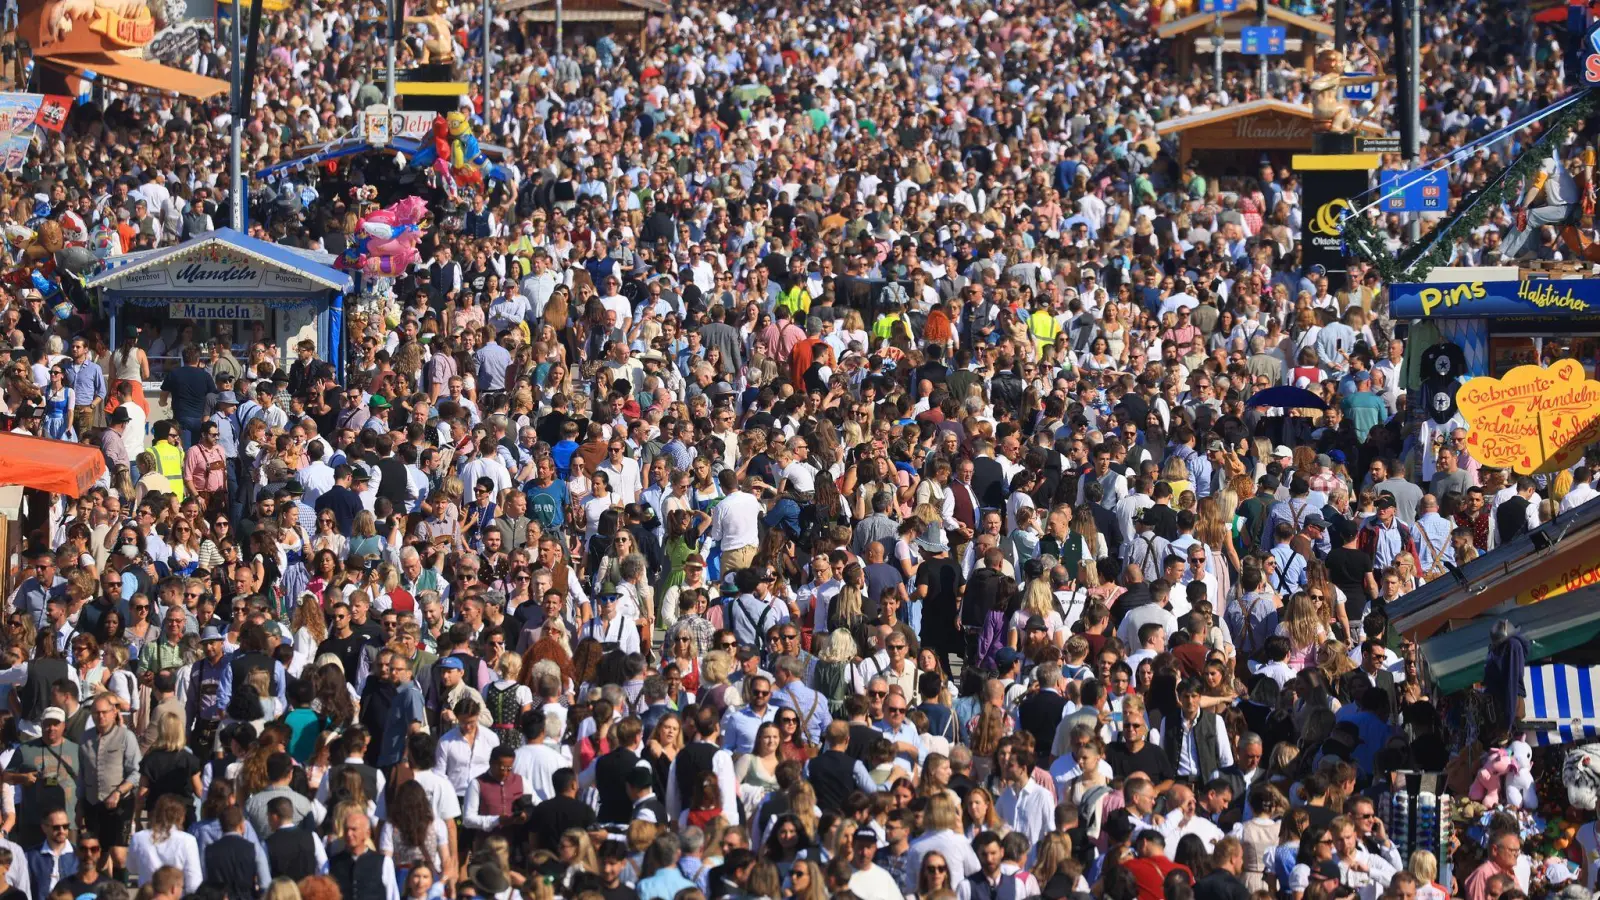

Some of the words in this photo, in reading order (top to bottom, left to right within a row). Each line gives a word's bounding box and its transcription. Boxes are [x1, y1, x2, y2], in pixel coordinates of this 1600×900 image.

[1425, 187, 1437, 195] U3
[176, 264, 257, 283] Mandeln
[275, 273, 303, 283] Popcorn
[1419, 281, 1486, 316] Pins
[1517, 280, 1590, 312] Halstücher
[183, 304, 250, 318] Mandeln
[1468, 377, 1550, 404] Gebrannte
[1527, 386, 1599, 412] Mandeln
[1482, 438, 1526, 459] Para
